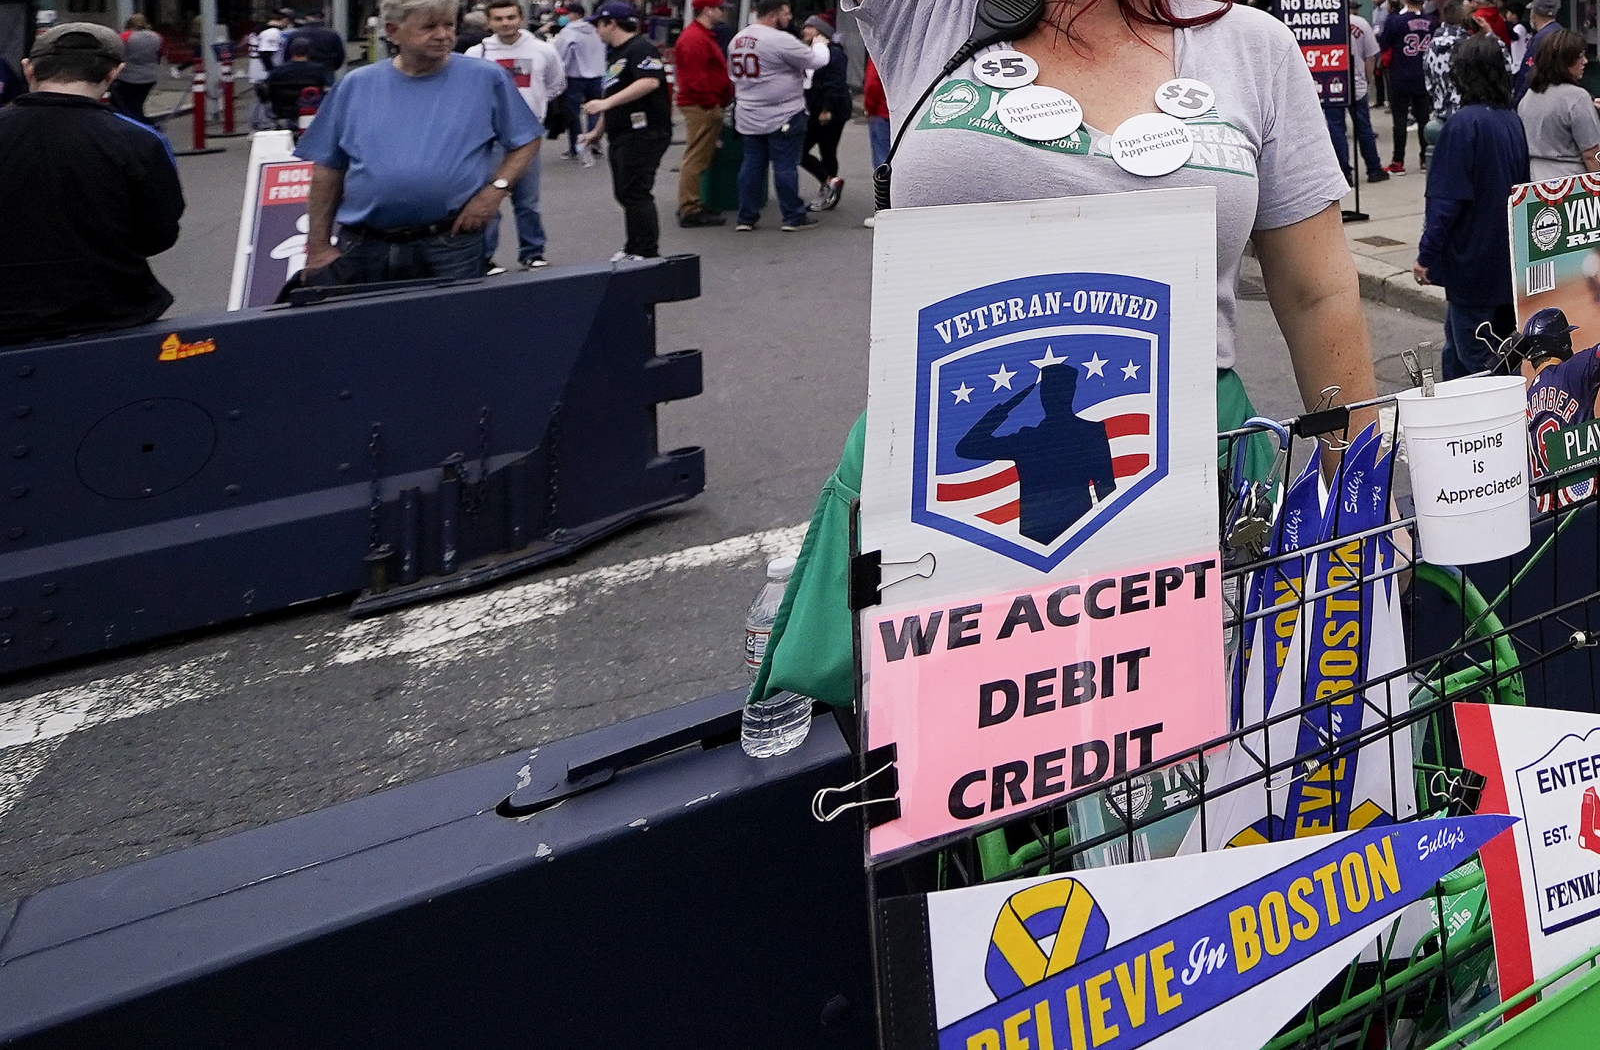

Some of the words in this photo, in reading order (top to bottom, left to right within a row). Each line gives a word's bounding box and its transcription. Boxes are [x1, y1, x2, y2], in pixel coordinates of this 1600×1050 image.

[1284, 12, 1339, 26] LARGER
[1294, 27, 1331, 40] THAN
[1403, 33, 1432, 57] 34
[731, 53, 760, 78] 50
[981, 57, 1028, 77] $5
[1004, 105, 1030, 115] Tips
[1030, 98, 1073, 112] Greatly
[1162, 84, 1209, 110] $5
[1009, 106, 1078, 124] Appreciated
[1115, 138, 1141, 149] Tips
[1143, 127, 1185, 142] Greatly
[1119, 135, 1190, 159] Appreciated
[1190, 124, 1247, 145] ERAN
[1190, 143, 1255, 170] NED
[278, 168, 312, 183] HOL
[933, 291, 1159, 345] VETERAN-OWNED
[1526, 386, 1579, 424] ARBER
[1446, 432, 1503, 457] Tipping
[1472, 459, 1485, 474] is
[1344, 470, 1365, 514] Sully's
[1436, 470, 1522, 504] Appreciated
[879, 603, 983, 664] WE
[996, 559, 1216, 642] ACCEPT
[1315, 537, 1366, 706] BOSTON
[978, 647, 1150, 730] DEBIT
[948, 723, 1164, 821] CREDIT
[1417, 826, 1466, 861] Sully's
[1542, 825, 1571, 847] EST.
[1181, 935, 1229, 987] In
[1227, 836, 1404, 974] BOSTON
